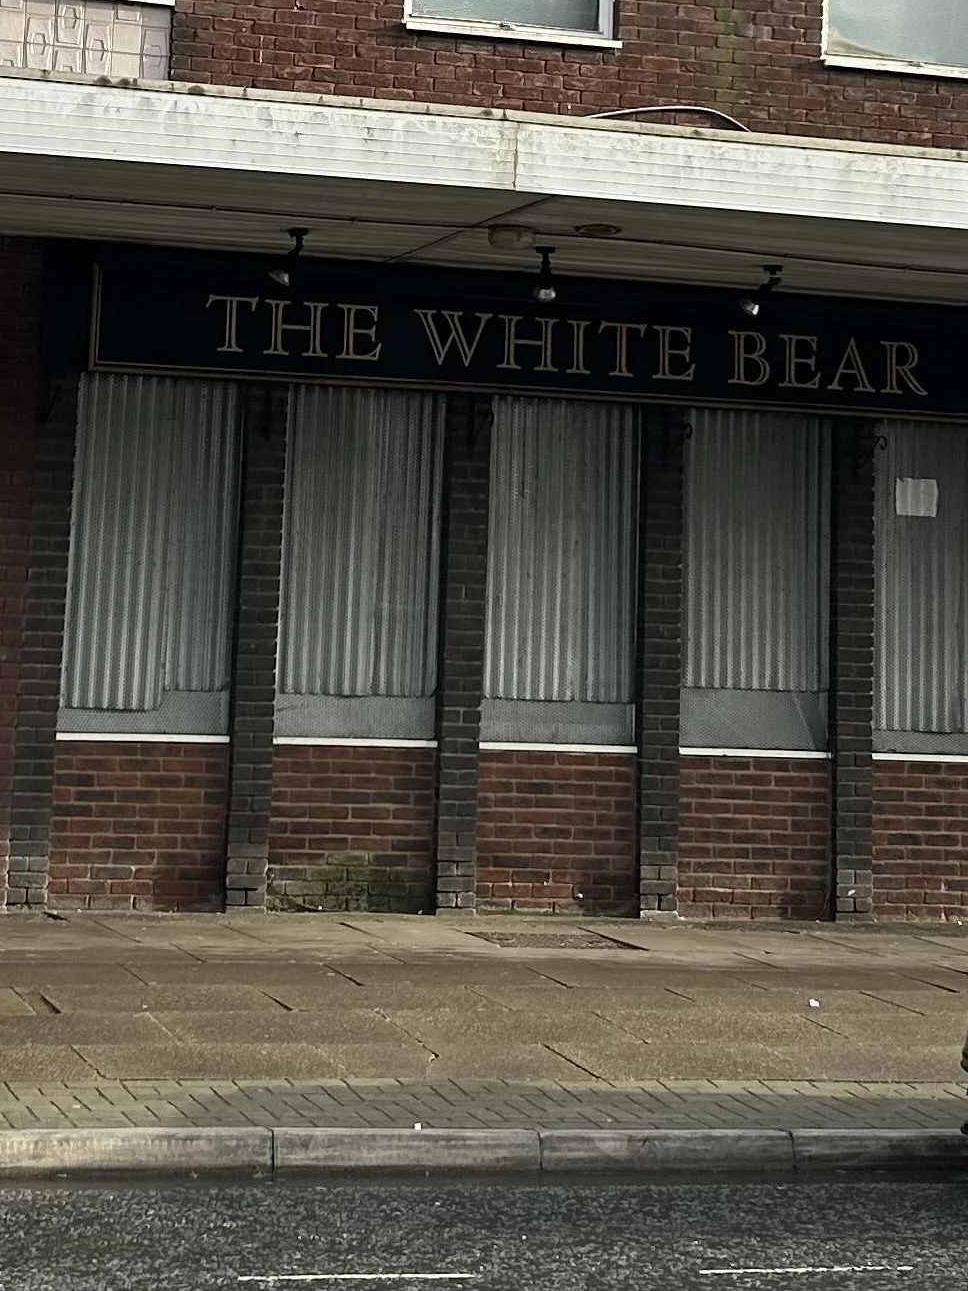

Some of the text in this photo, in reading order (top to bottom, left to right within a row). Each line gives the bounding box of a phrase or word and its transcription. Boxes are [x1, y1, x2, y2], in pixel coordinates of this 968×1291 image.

[205, 294, 929, 397] THE WHITE BEAR
